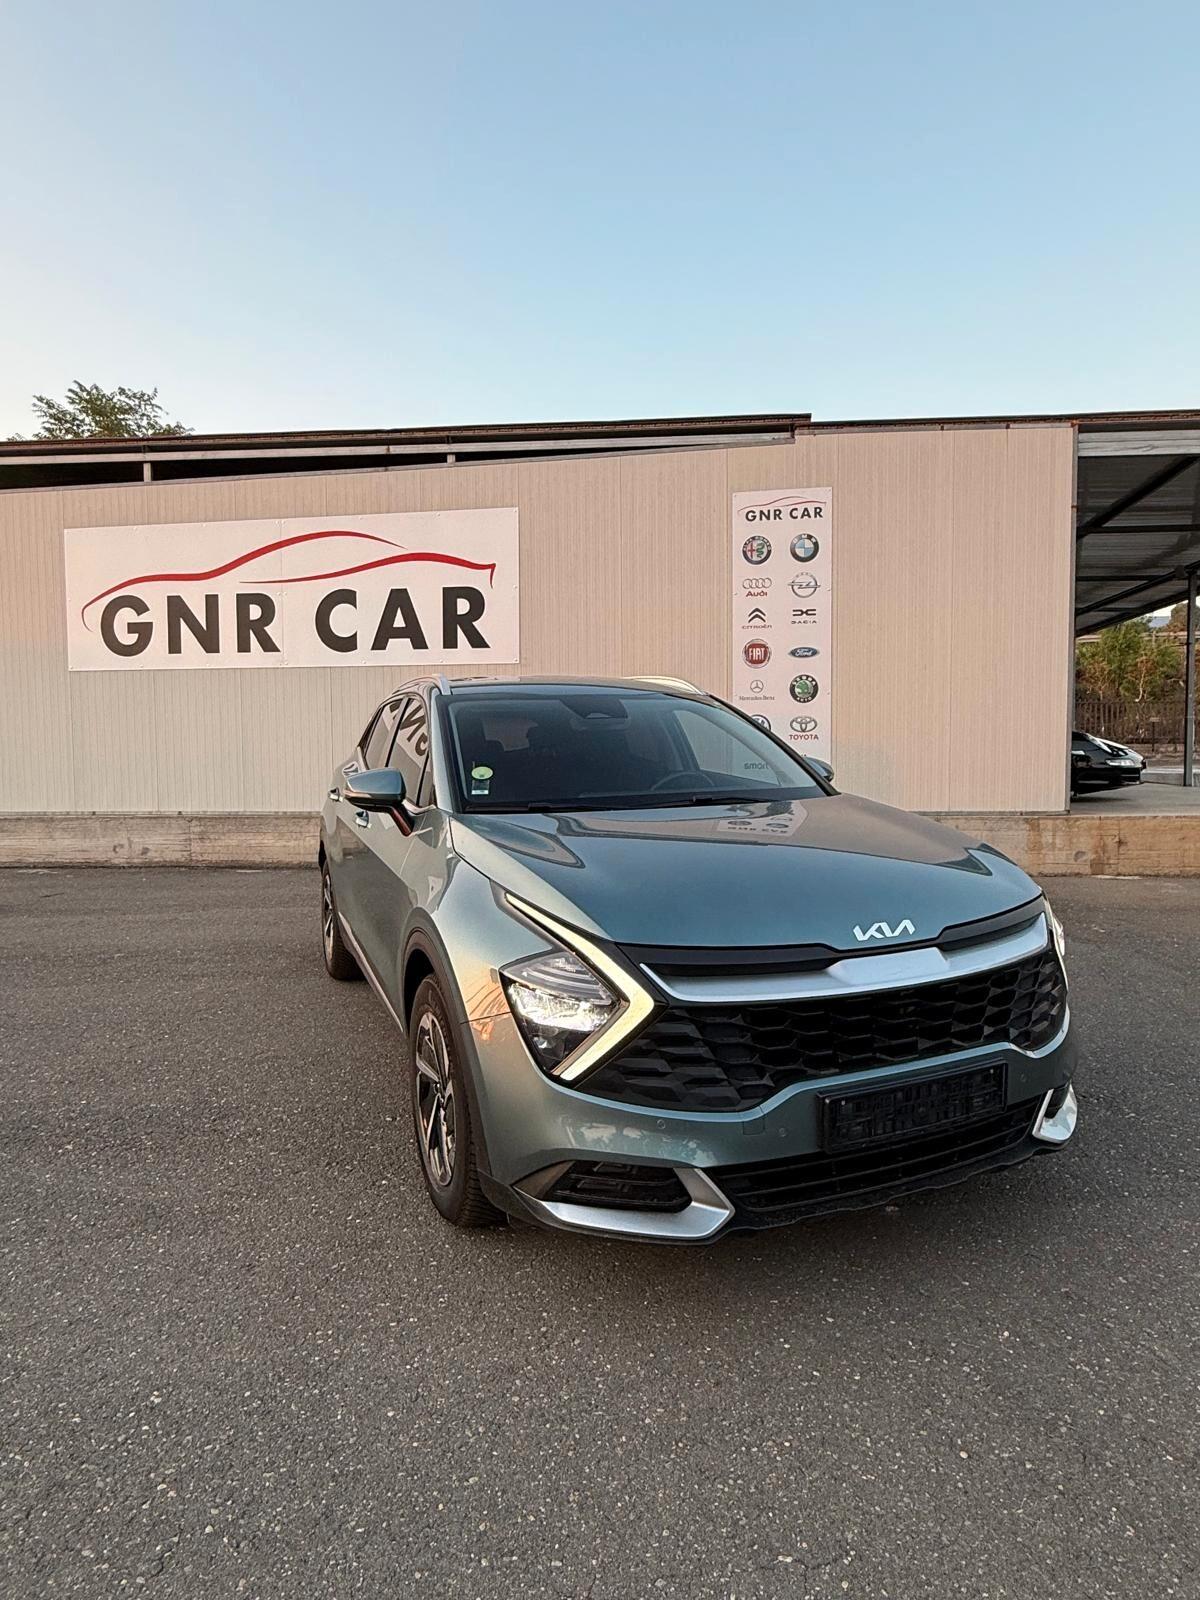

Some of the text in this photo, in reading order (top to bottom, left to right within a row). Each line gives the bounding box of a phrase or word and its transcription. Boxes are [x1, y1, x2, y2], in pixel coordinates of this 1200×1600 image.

[745, 506, 823, 522] GNR CAR
[745, 590, 768, 598] Audi
[100, 586, 491, 657] GNR CAR
[748, 647, 766, 661] FIAT
[795, 649, 813, 657] Ford
[852, 919, 916, 942] KIA
